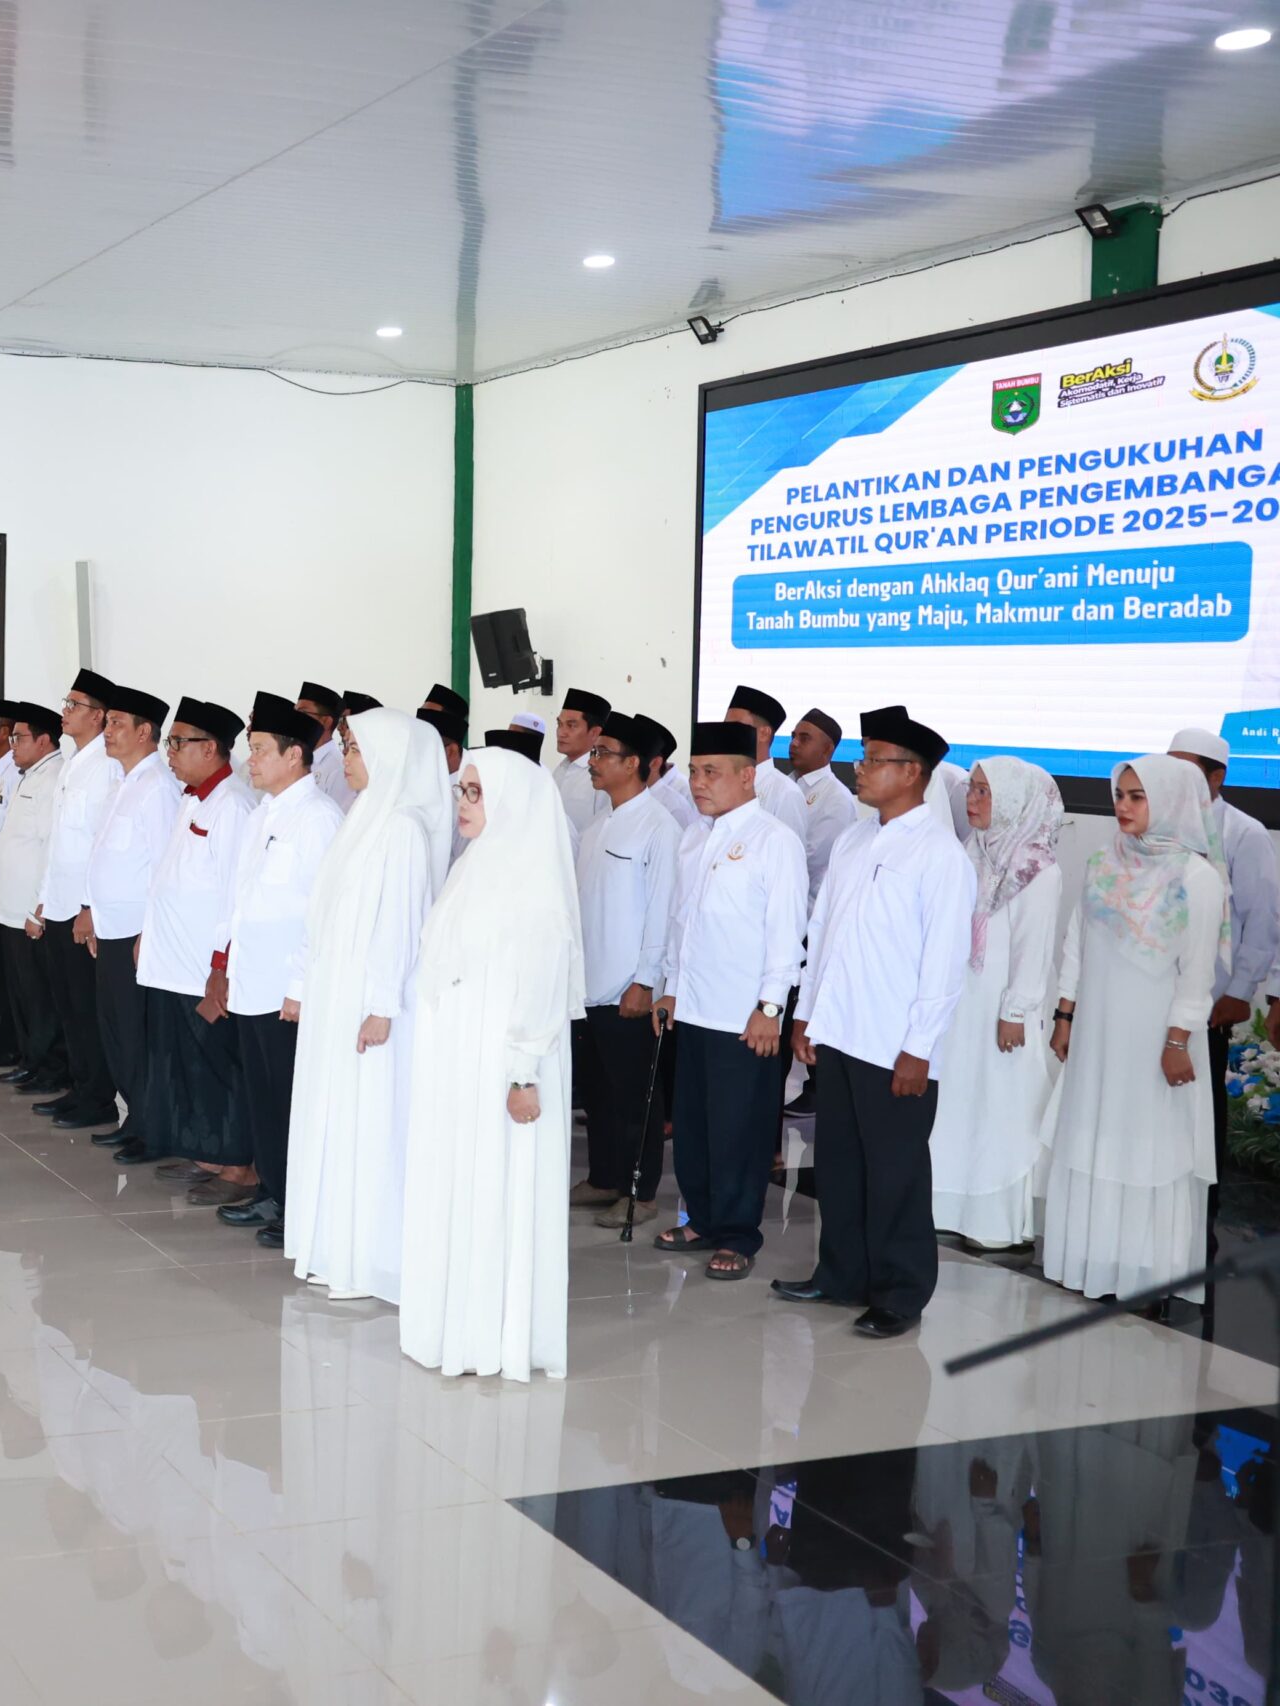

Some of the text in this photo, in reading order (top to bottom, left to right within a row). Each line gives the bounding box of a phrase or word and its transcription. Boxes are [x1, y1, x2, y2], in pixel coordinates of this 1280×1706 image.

[1061, 358, 1132, 389] BerAksi
[1117, 373, 1142, 388] Kerja
[787, 428, 1263, 505] PELANTIKAN DAN PENGUKUHAN
[750, 507, 874, 536] PENGURUS
[880, 491, 1013, 523] LEMBAGA
[747, 535, 869, 561] TILAWATIL
[875, 525, 978, 554] QUR'AN
[986, 514, 1115, 543] PERIODE
[775, 579, 842, 601] BerAksi
[847, 577, 914, 602] dengan
[921, 571, 990, 597] Ahklaq
[1086, 560, 1175, 590] Menuju
[746, 593, 1232, 633] Tanah Bumbu yang Maju, Makmur dan Beradab
[1241, 727, 1267, 737] Andi
